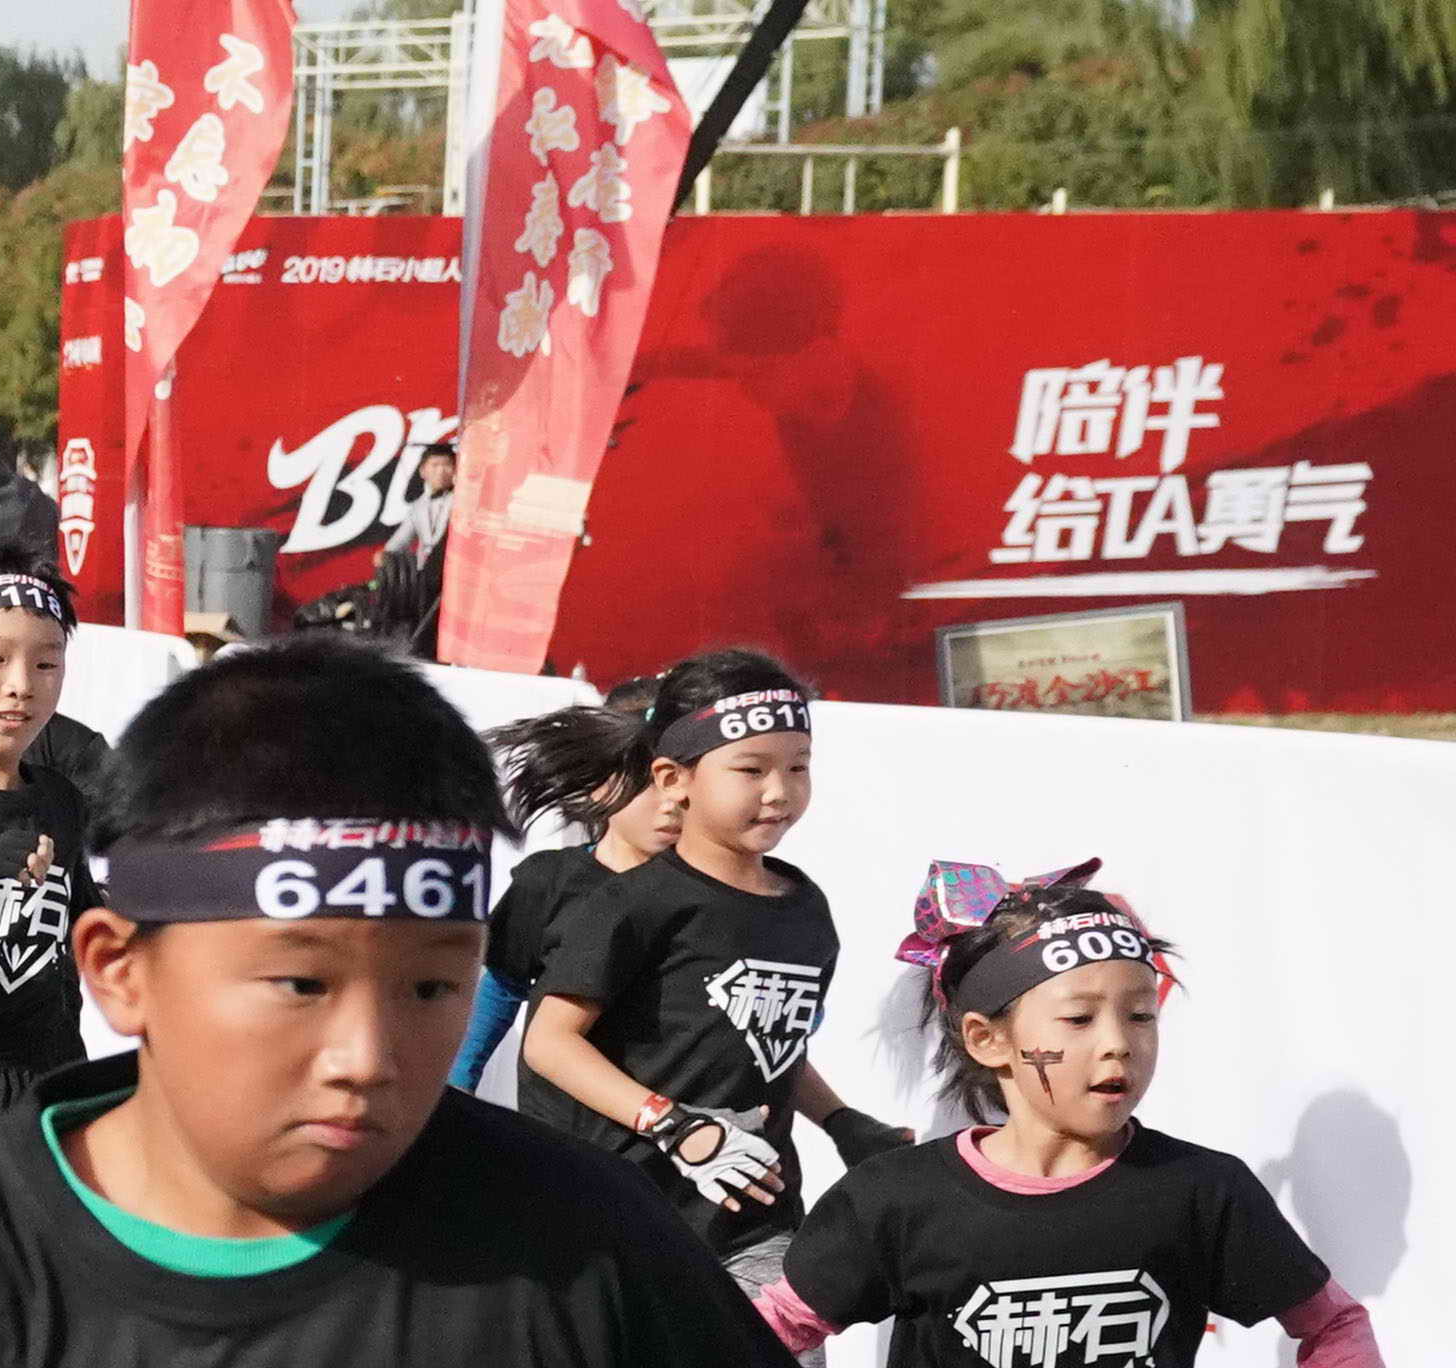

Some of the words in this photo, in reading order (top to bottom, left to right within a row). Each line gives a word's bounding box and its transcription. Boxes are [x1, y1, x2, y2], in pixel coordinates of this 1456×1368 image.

[1010, 355, 1225, 470] 陪伴
[990, 459, 1373, 564] 给TA勇气
[719, 703, 810, 740] 6611
[254, 856, 486, 921] 6461
[725, 970, 821, 1035] 赫石
